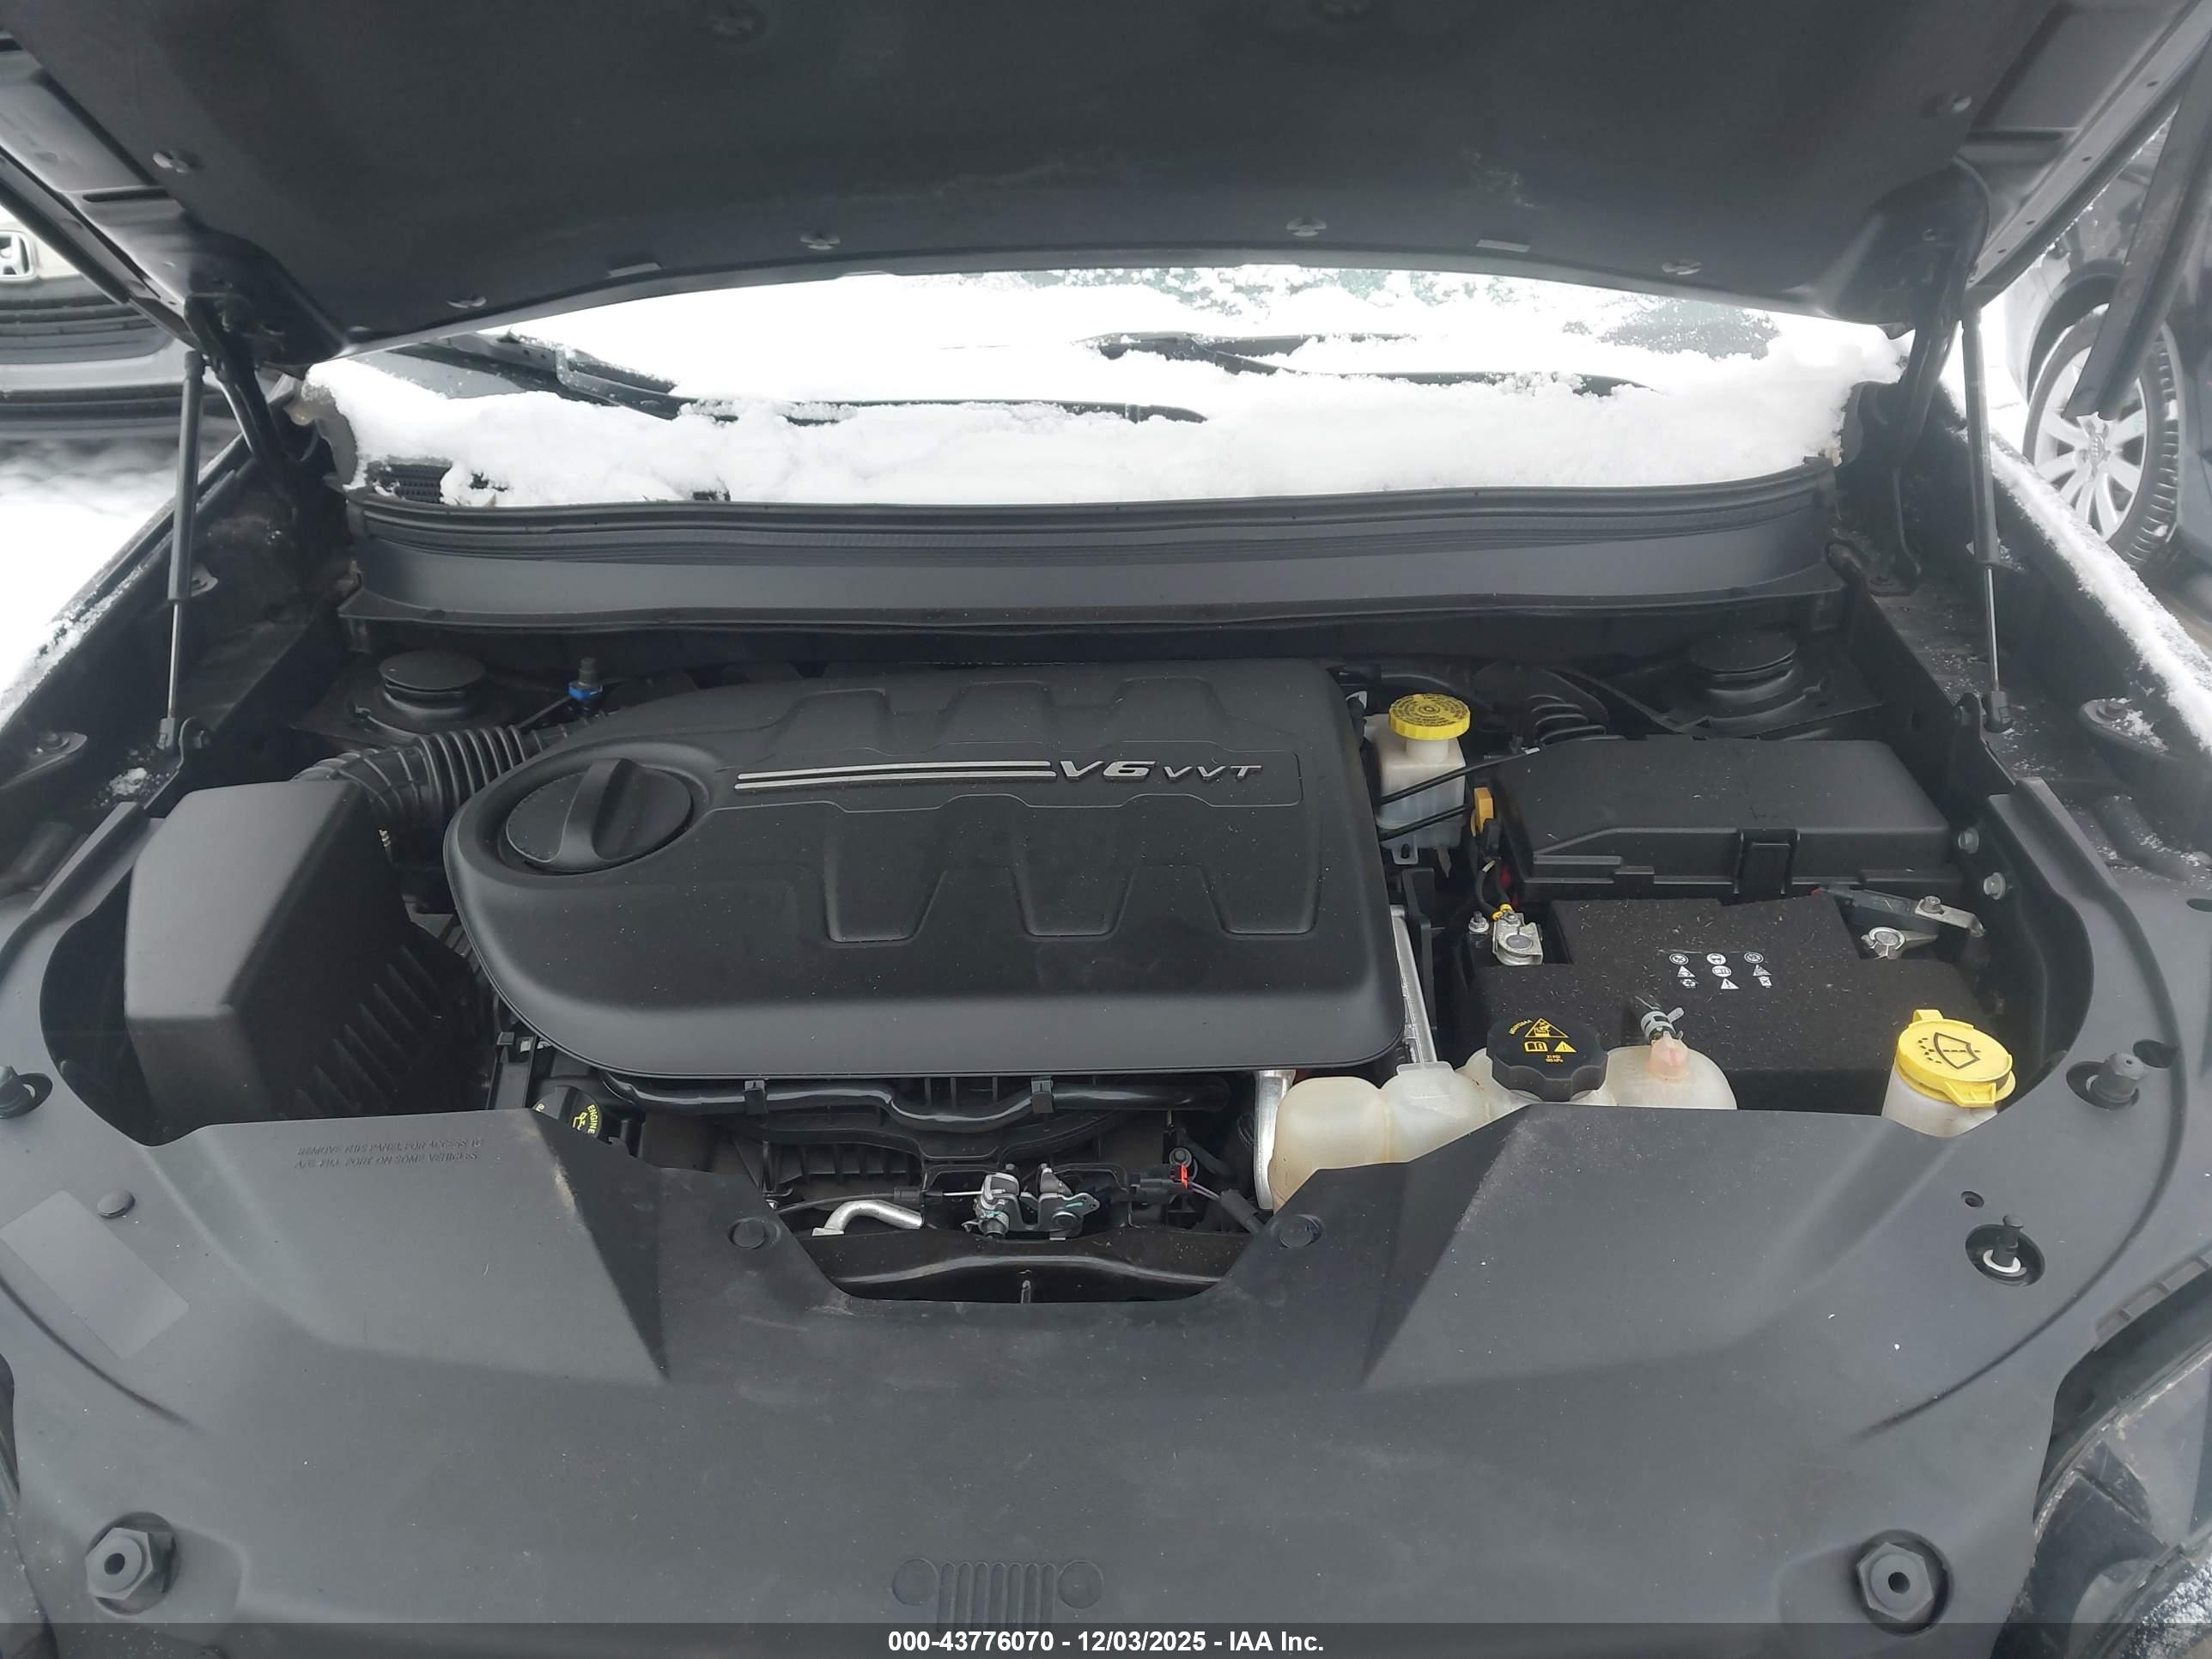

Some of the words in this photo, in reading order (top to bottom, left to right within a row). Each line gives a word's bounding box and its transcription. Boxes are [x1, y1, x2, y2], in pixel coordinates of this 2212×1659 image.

[1059, 760, 1157, 780] V6
[1163, 764, 1262, 781] VVT
[587, 1104, 599, 1134] ENGINE
